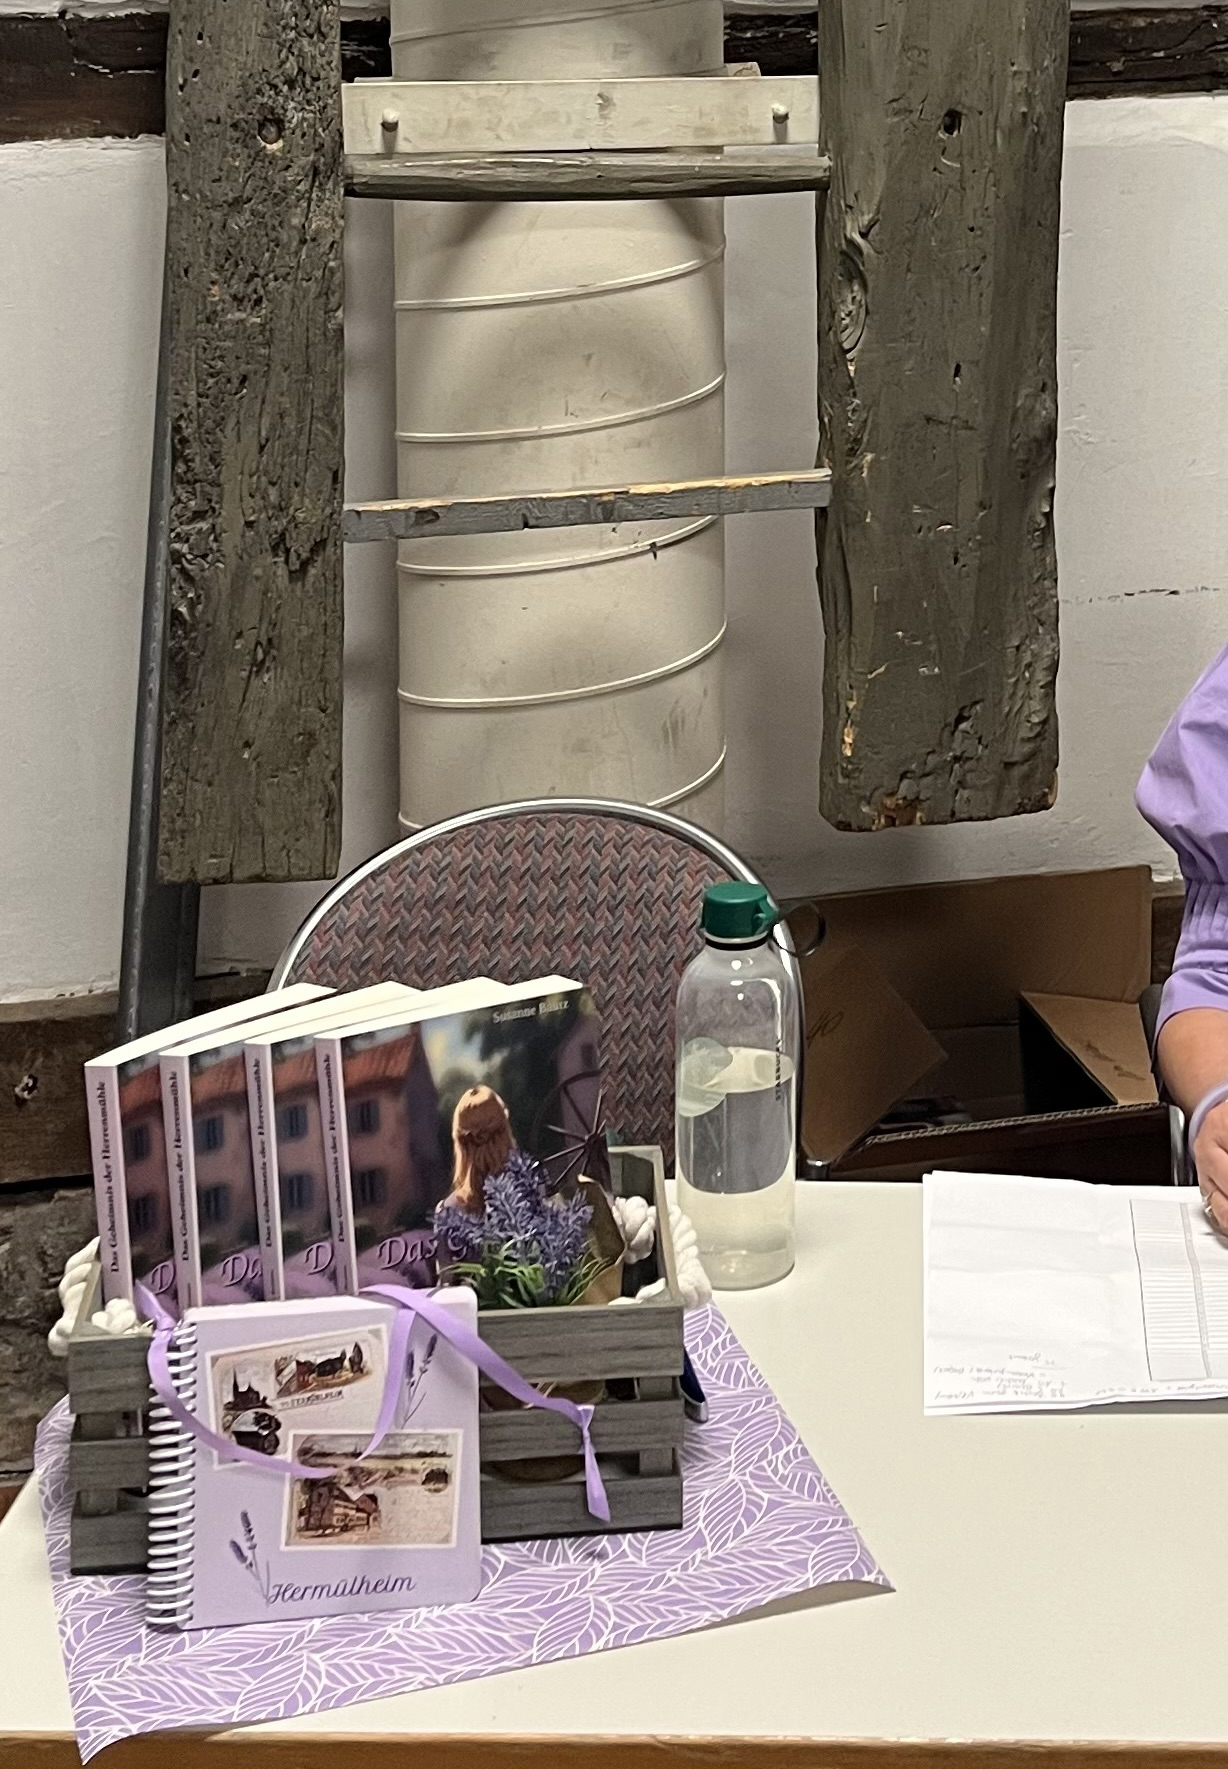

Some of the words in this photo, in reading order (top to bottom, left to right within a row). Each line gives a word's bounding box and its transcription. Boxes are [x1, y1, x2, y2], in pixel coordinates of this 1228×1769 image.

[493, 1006, 537, 1024] Susanne
[96, 1080, 111, 1160] Herrenmühle
[256, 1138, 268, 1159] der
[329, 1133, 339, 1154] der
[102, 1162, 113, 1182] der
[173, 1152, 184, 1172] der
[104, 1185, 119, 1248] Geheimnis
[176, 1174, 188, 1237] Geheimnis
[180, 1239, 190, 1261] Das
[376, 1230, 442, 1271] Das
[109, 1251, 120, 1273] Das
[221, 1253, 263, 1289] Da
[268, 1574, 417, 1606] Hermülheim
